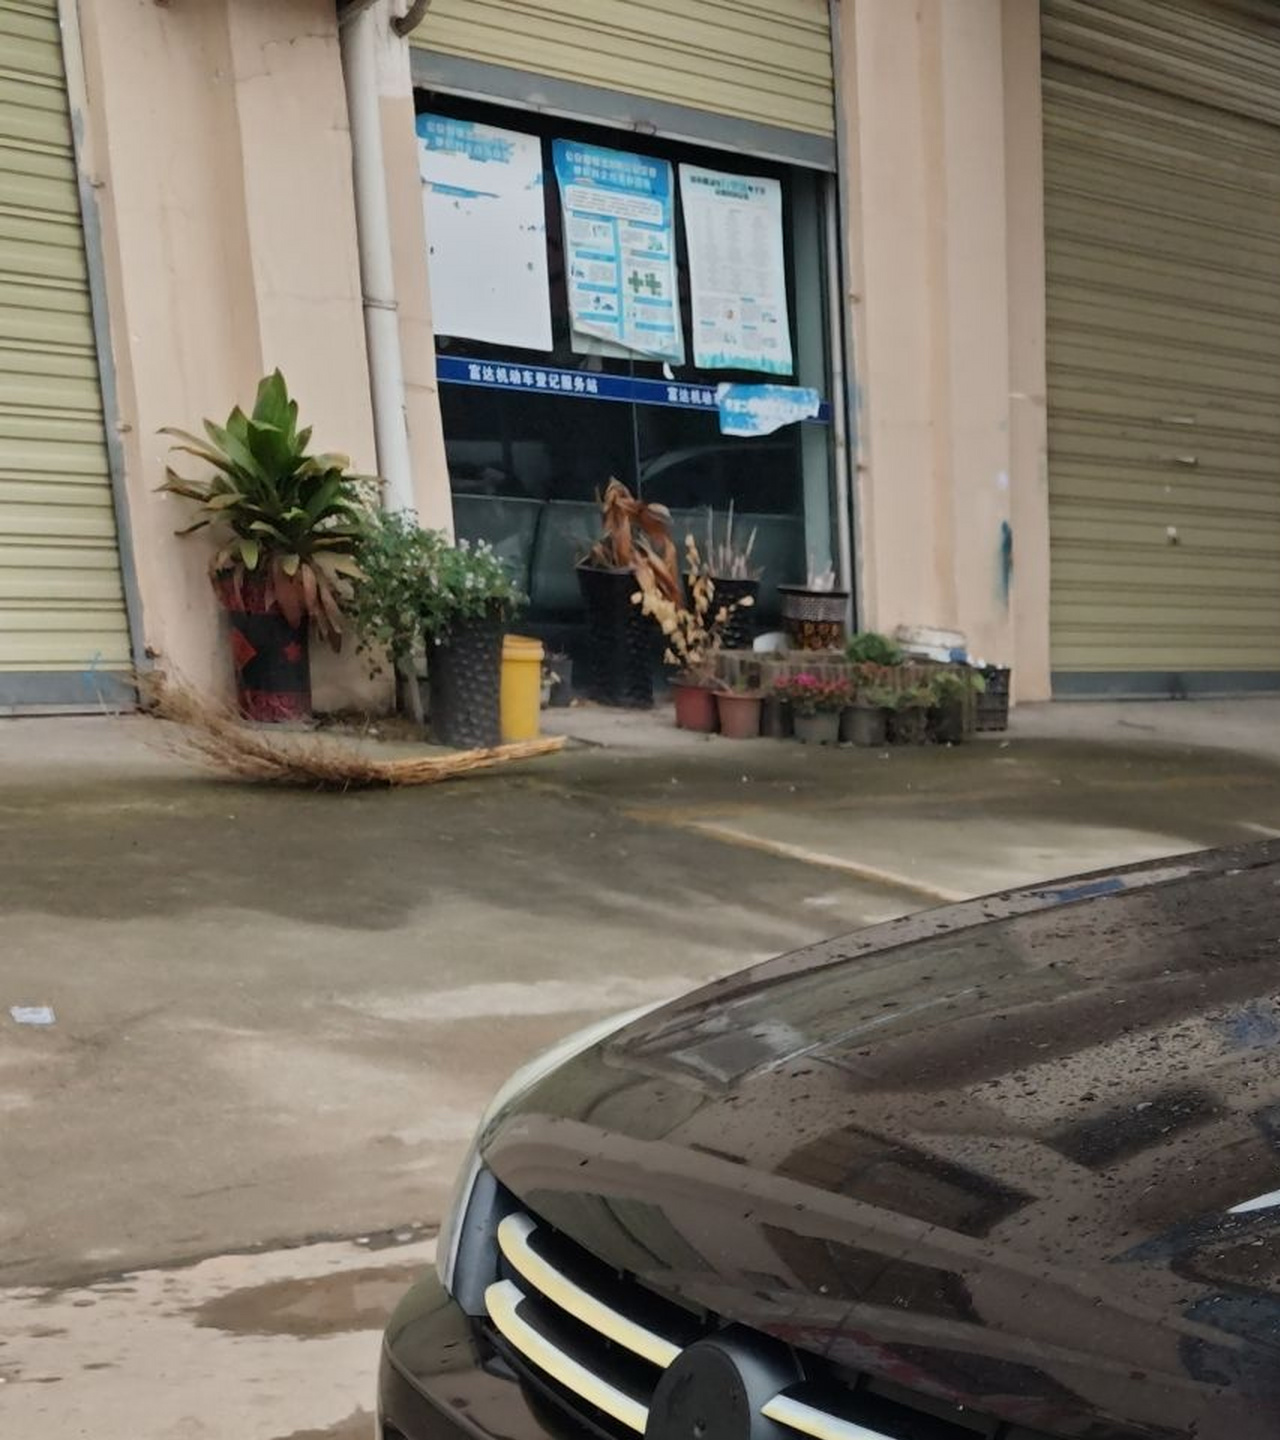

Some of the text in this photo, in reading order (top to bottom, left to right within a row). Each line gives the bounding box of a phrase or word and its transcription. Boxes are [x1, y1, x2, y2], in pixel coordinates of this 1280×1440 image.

[468, 363, 599, 394] 富达机动车登记服务站
